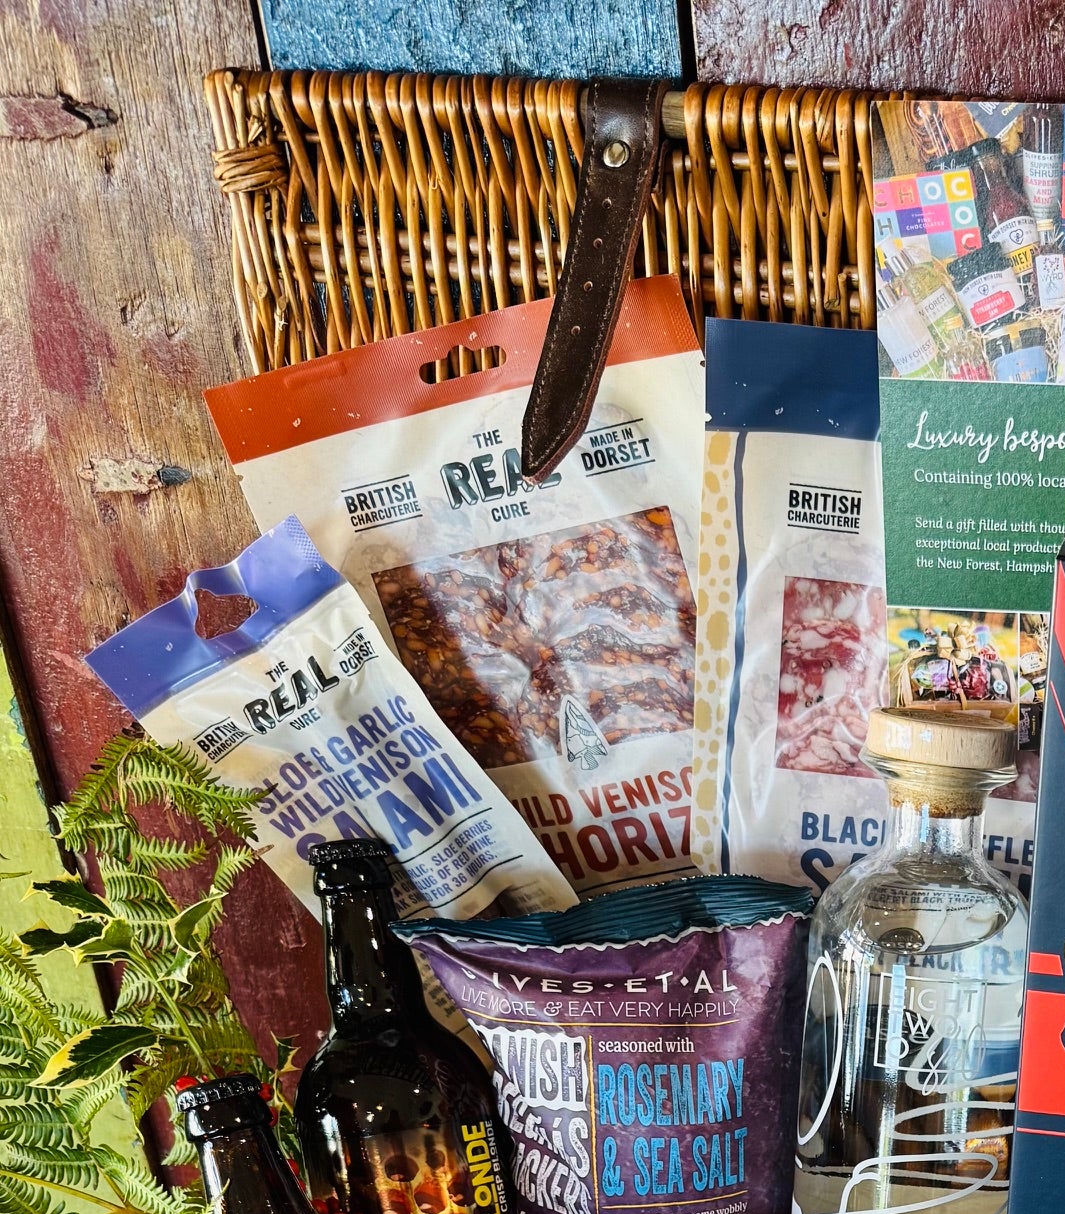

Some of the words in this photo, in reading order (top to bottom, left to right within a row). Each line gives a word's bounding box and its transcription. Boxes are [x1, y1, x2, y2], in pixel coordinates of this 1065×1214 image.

[473, 429, 503, 449] THE
[590, 433, 619, 448] MADE
[621, 428, 633, 441] IN
[907, 411, 999, 463] Luxury
[581, 439, 652, 471] DORSET
[914, 469, 992, 488] Containing
[995, 472, 1034, 487] 100%
[344, 481, 417, 515] BRITISH
[789, 487, 861, 516] BRITISH
[351, 501, 421, 527] CHARCUTERIE
[491, 502, 531, 523] CURE
[787, 509, 860, 529] CHARCUTERIE
[915, 517, 943, 529] Send
[946, 521, 953, 530] a
[956, 518, 976, 533] gift
[978, 519, 1007, 533] filled
[1010, 520, 1036, 533] with
[242, 656, 340, 735] REAL
[289, 708, 321, 731] CURE
[258, 752, 323, 816] SLOE
[314, 747, 332, 772] &
[326, 695, 416, 770] GARLIC
[461, 985, 489, 1008] LIVE
[487, 999, 537, 1018] MORE
[543, 1001, 563, 1017] &
[568, 1001, 604, 1017] EAT
[604, 1001, 664, 1018] VERY
[668, 999, 739, 1018] HAPPILY
[598, 1038, 663, 1053] seasoned
[666, 1038, 695, 1053] with
[598, 1058, 745, 1128] ROSEMARY
[602, 1137, 624, 1198] &
[634, 1136, 685, 1197] SEA
[692, 1127, 748, 1192] SALT
